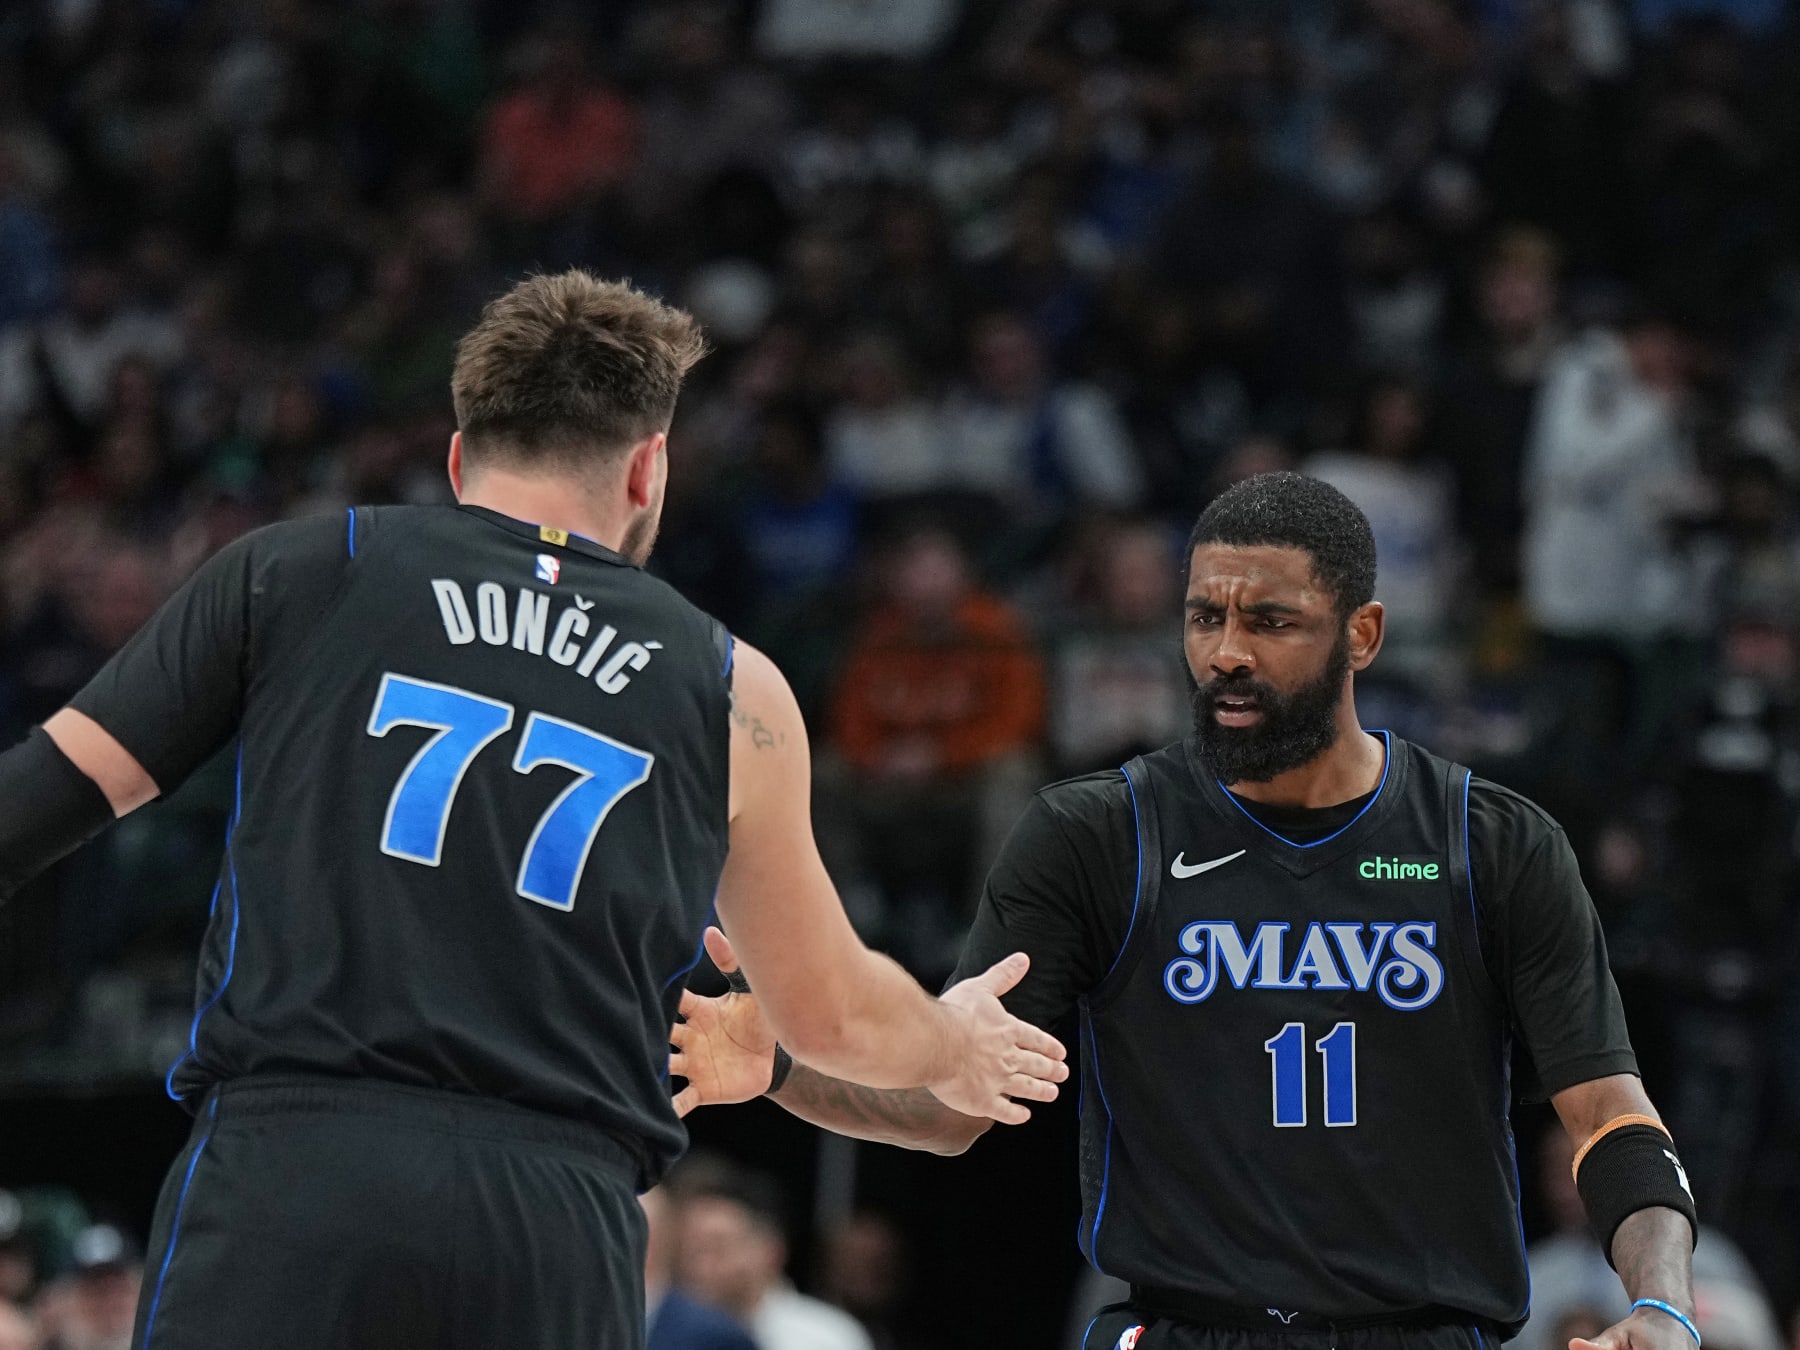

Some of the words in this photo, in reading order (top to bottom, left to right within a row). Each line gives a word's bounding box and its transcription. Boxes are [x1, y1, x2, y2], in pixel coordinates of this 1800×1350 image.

[432, 579, 663, 694] DONČIĆ
[367, 672, 655, 912] 77
[1359, 856, 1439, 880] chime
[1164, 921, 1445, 1011] MAVS
[1265, 1022, 1358, 1127] 11
